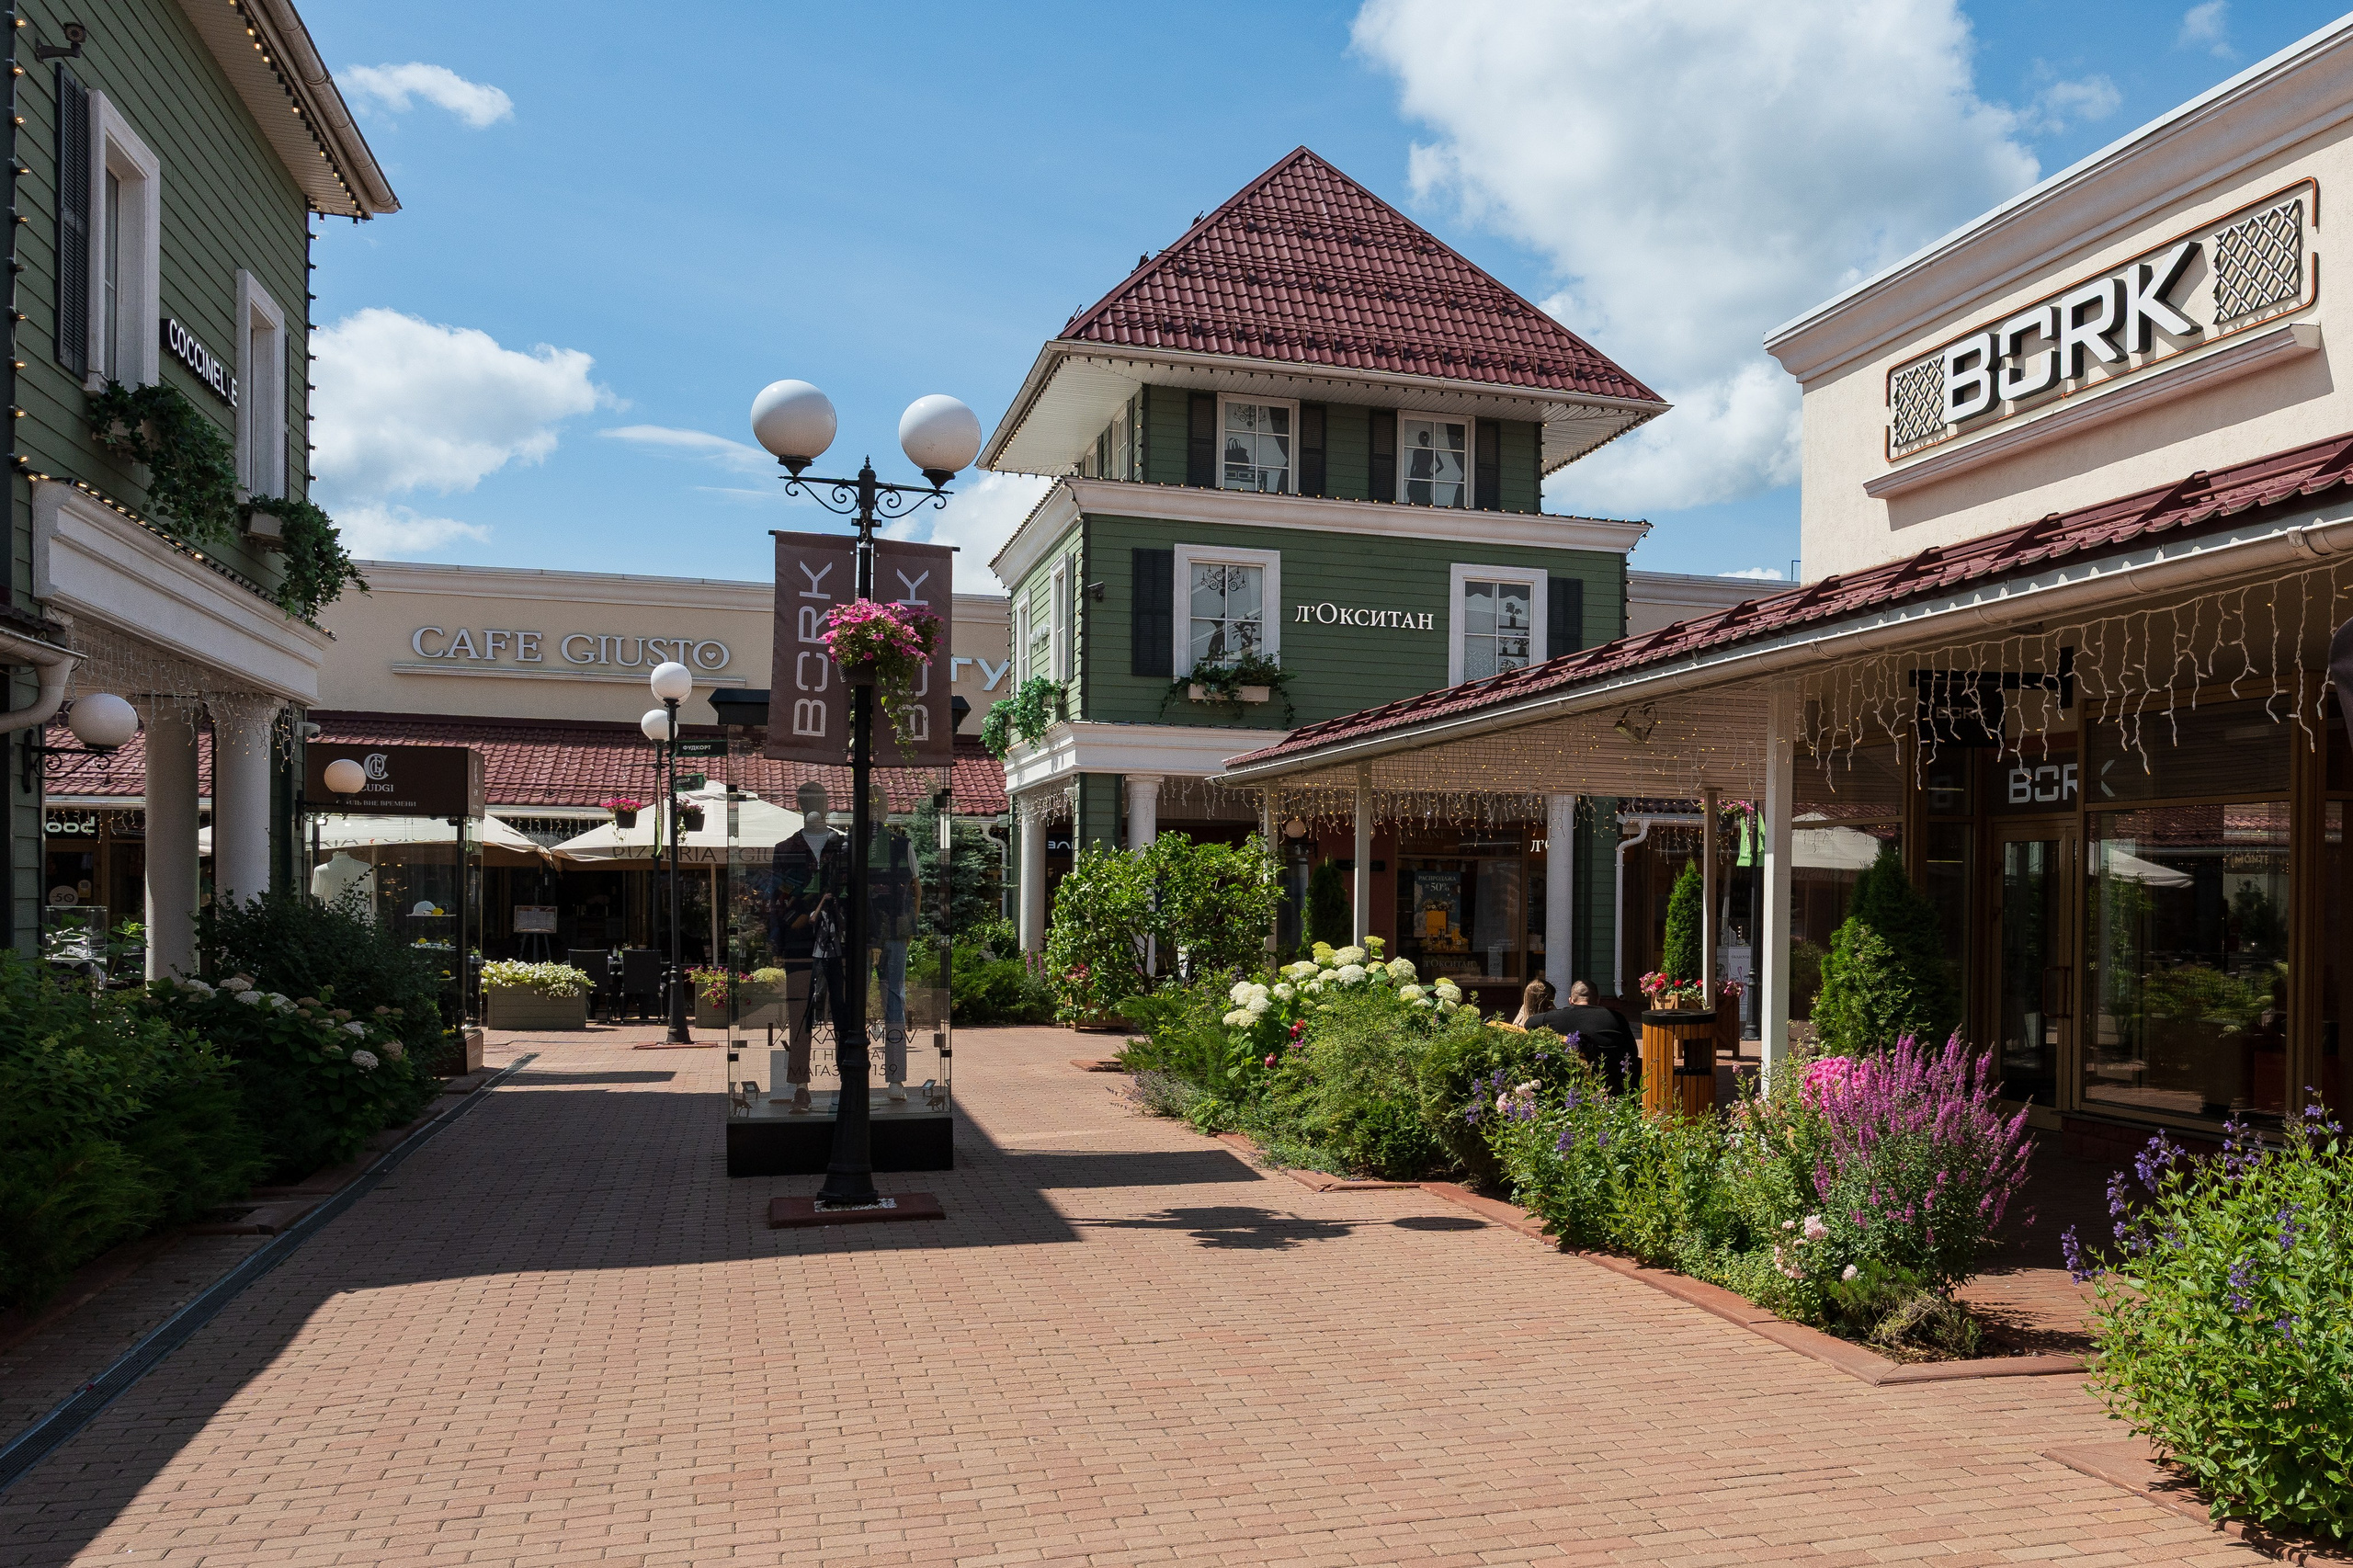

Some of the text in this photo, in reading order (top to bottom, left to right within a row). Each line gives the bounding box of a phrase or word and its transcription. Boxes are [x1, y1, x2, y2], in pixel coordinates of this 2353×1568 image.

[1945, 241, 2203, 425] BORK
[169, 319, 238, 407] COCCINELLE
[413, 627, 730, 670] CAFE GIUSTO
[792, 561, 832, 736] BORK
[1936, 707, 1988, 720] BORK
[2009, 759, 2115, 803] BORK
[612, 846, 717, 861] PIZERIA
[873, 1063, 898, 1077] 159
